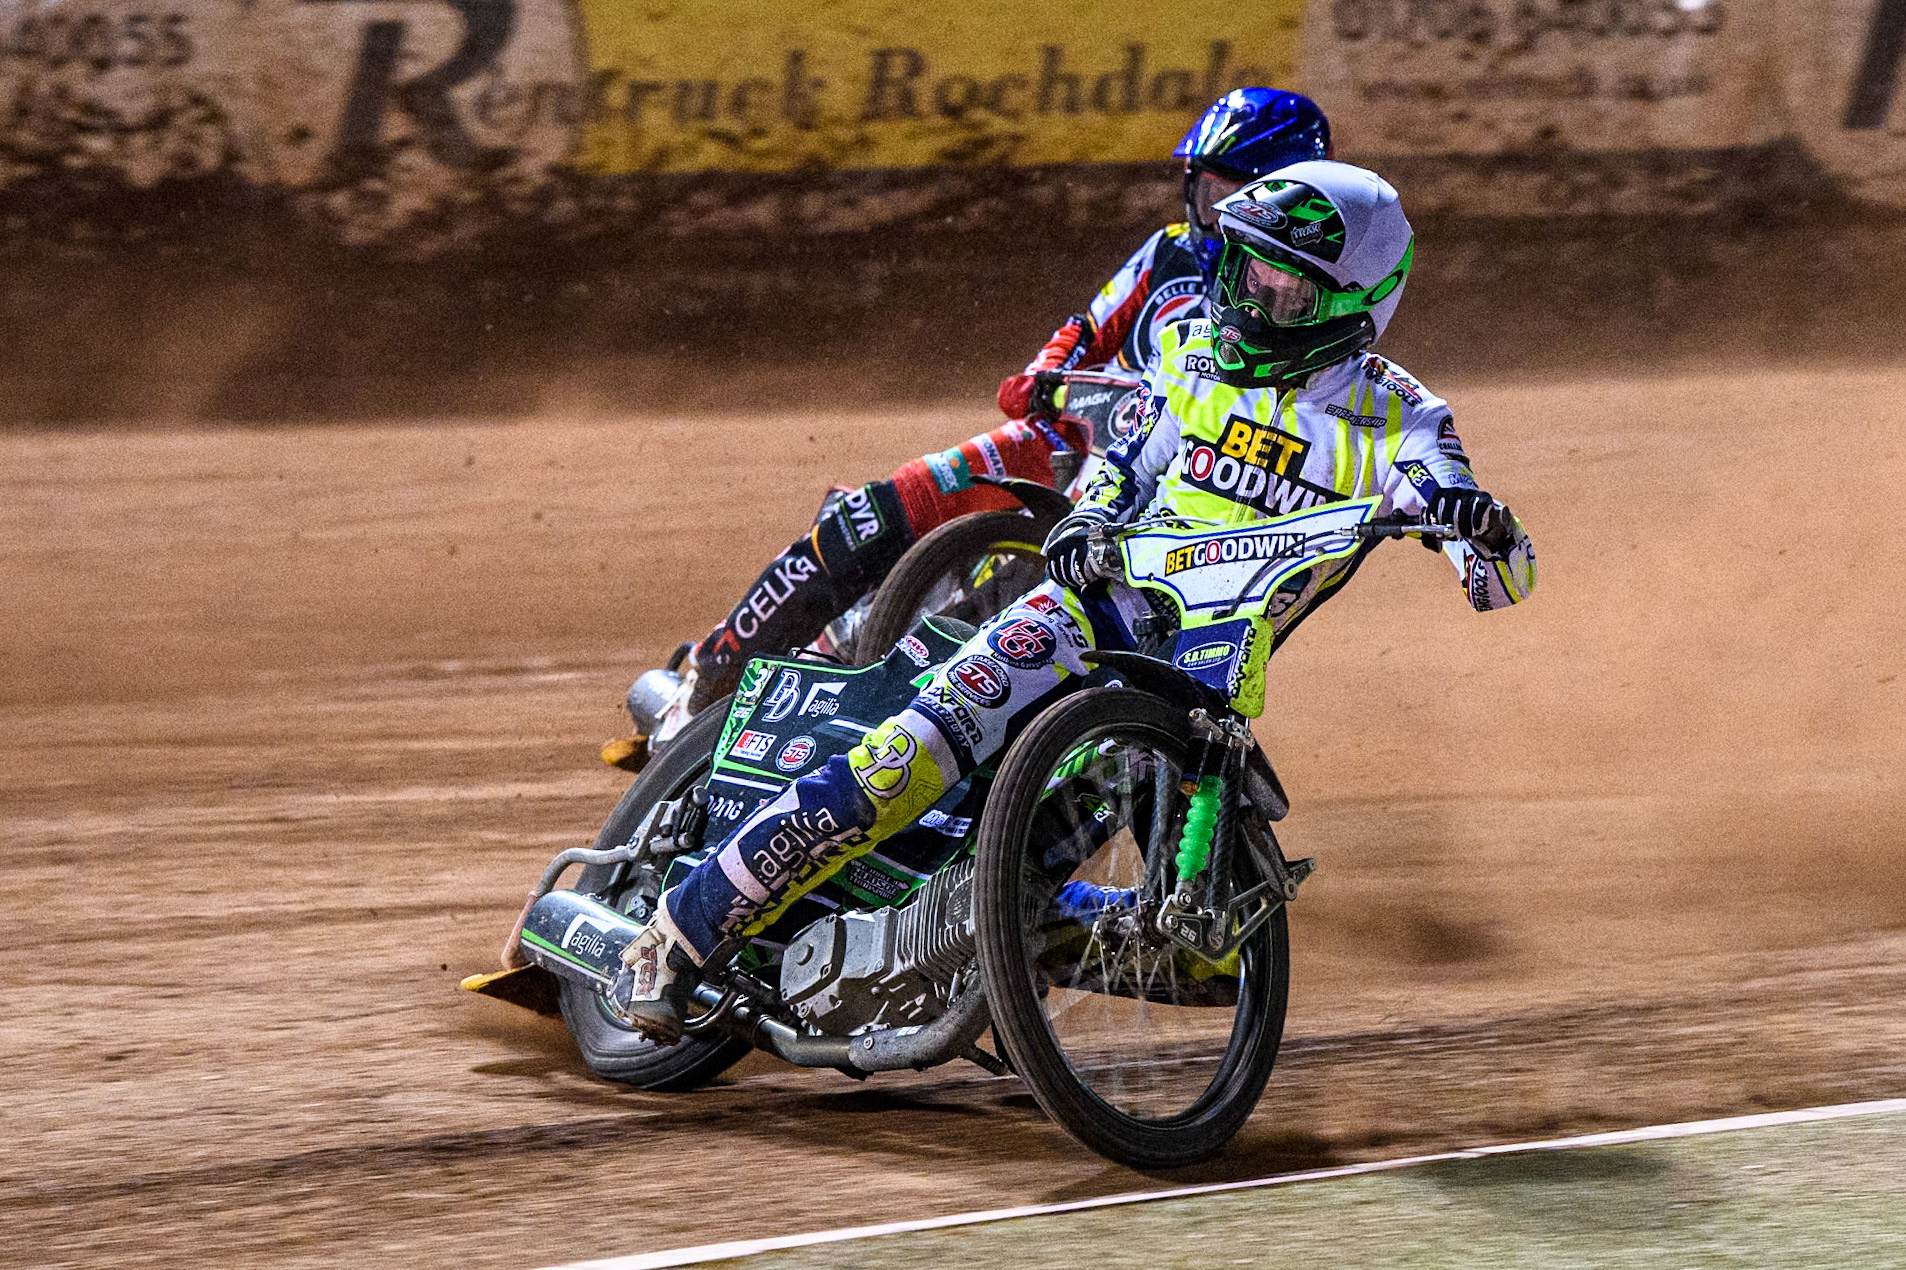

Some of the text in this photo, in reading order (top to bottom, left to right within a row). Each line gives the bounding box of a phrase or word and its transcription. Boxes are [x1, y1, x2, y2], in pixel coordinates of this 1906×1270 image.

[1155, 283, 1197, 306] BELLE
[1220, 328, 1239, 340] STS
[1221, 421, 1304, 476] BET
[845, 486, 880, 541] DVR
[1165, 534, 1304, 577] BETGOODWIN
[1045, 605, 1090, 649] FTS
[956, 663, 1001, 694] STS
[966, 655, 1009, 687] STAKEFORD
[808, 697, 841, 718] agilia
[956, 682, 992, 706] SERVICES
[747, 733, 774, 752] FTS
[783, 746, 809, 760] STS
[753, 806, 840, 878] agilia
[570, 931, 606, 958] agilia
[1180, 922, 1197, 943] 26
